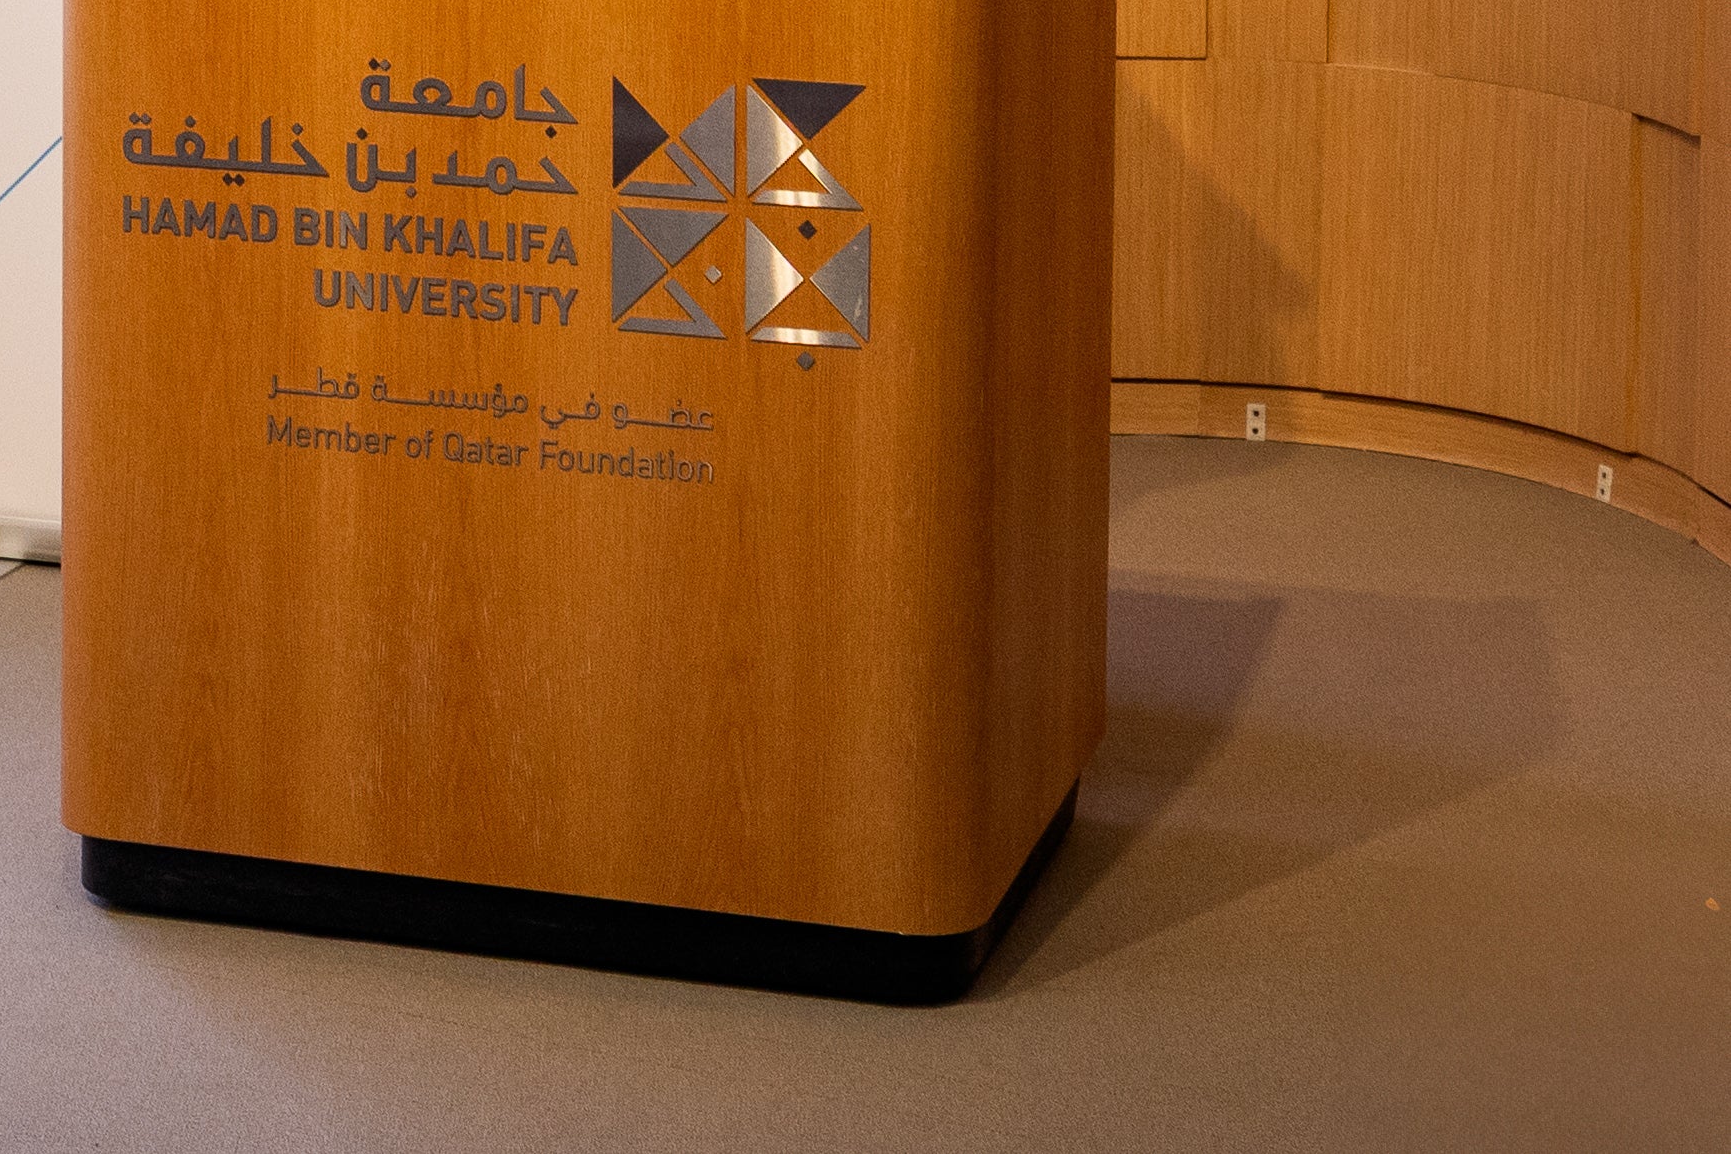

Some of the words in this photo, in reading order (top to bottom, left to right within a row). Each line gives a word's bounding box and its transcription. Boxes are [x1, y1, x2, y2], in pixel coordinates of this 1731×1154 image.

[359, 57, 579, 138] جامعة
[121, 112, 330, 188] خليفة
[345, 127, 418, 199] بن
[432, 151, 579, 194] حمد
[121, 197, 278, 243] HAMAD
[294, 208, 370, 249] BIN
[383, 215, 579, 267] KHALIFA
[313, 268, 579, 326] UNIVERSITY
[267, 367, 361, 402] قطر
[372, 376, 529, 419] مؤسسة
[539, 391, 602, 430] في
[613, 398, 716, 432] عضو
[267, 414, 397, 458] Member
[405, 429, 436, 458] of
[442, 432, 529, 470] Qatar
[539, 439, 716, 484] Foundation
